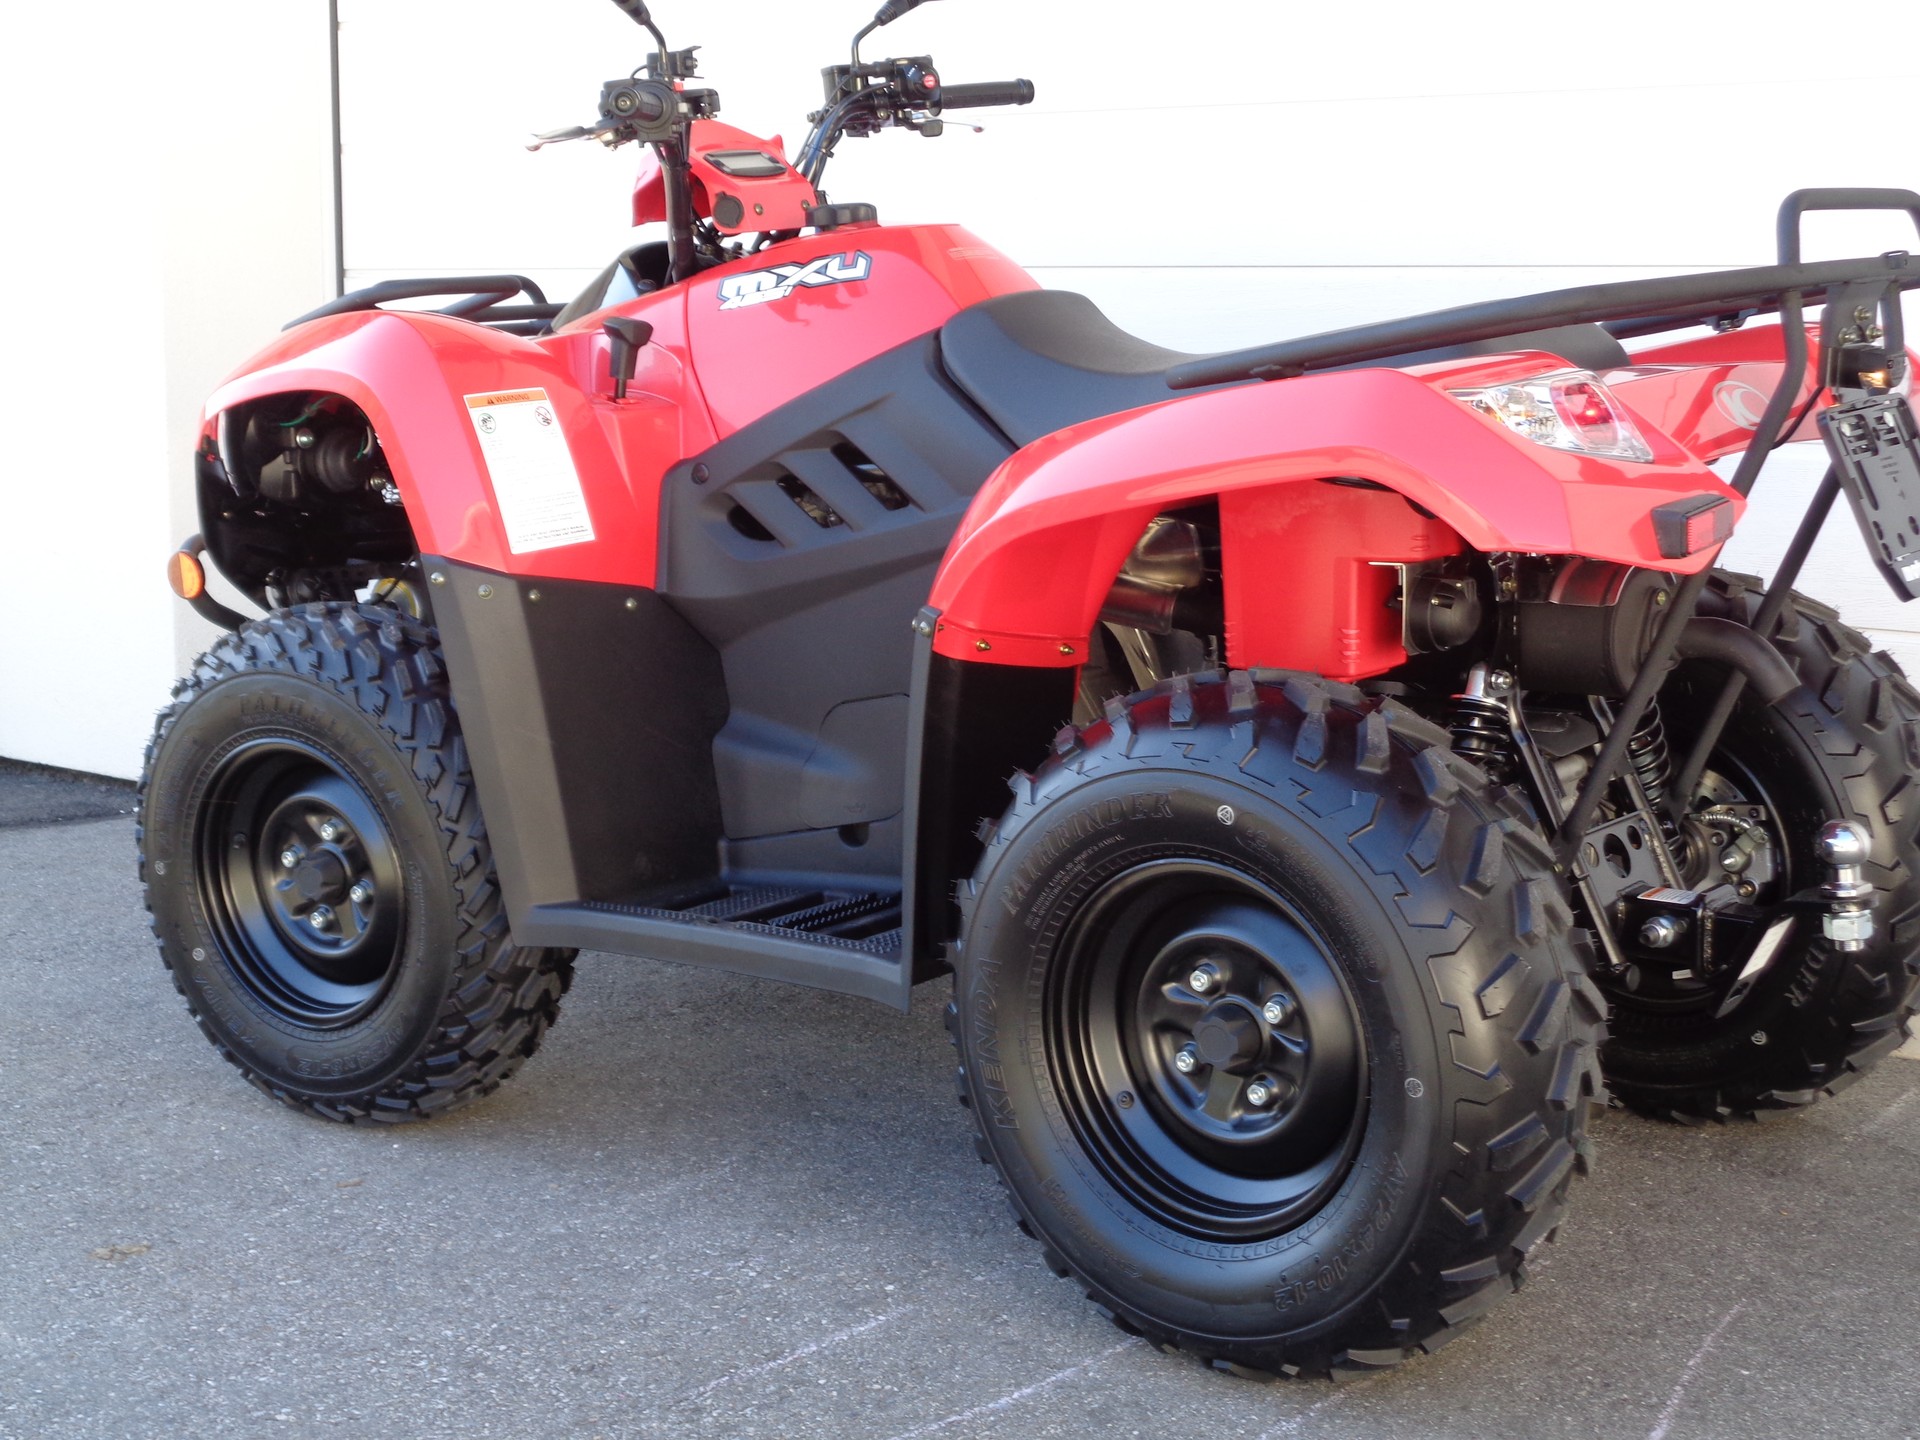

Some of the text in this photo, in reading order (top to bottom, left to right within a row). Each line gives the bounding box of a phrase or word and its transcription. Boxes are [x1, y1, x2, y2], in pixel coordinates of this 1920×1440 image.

[719, 251, 870, 300] MXU
[495, 393, 530, 403] WARNING
[1000, 792, 1174, 916] PATHFINDER
[974, 957, 1020, 1131] KENDA
